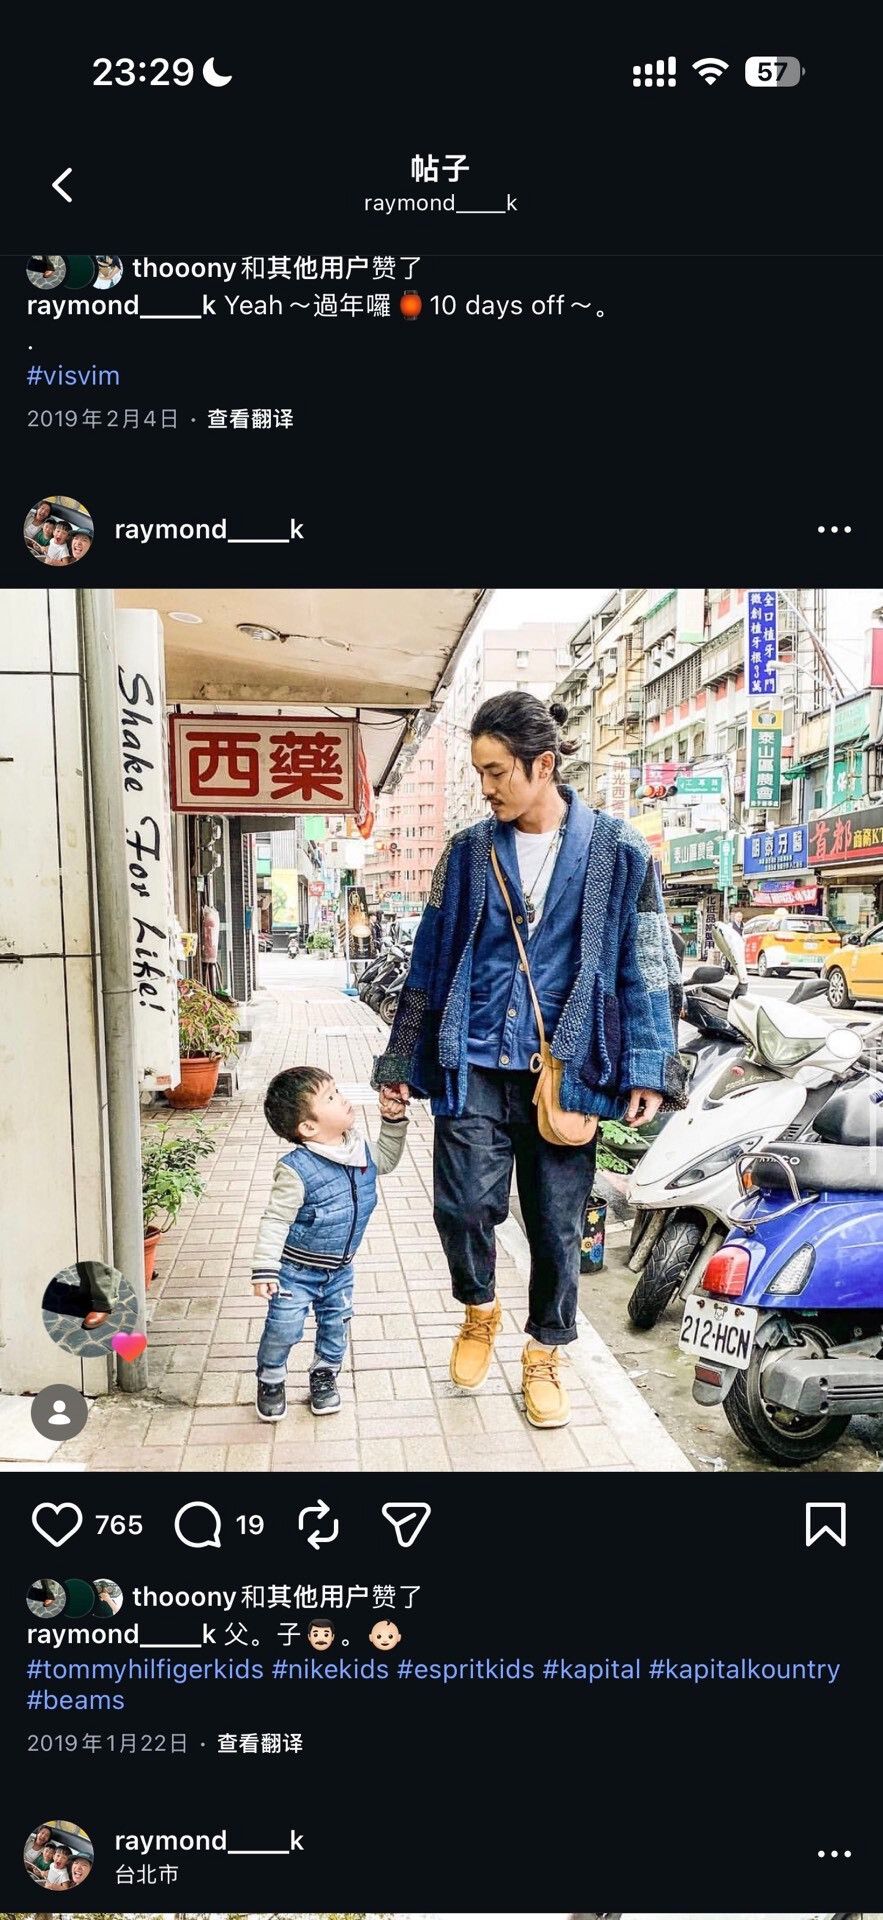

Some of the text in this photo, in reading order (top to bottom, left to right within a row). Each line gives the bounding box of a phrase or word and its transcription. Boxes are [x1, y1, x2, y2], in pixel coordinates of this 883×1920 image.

[93, 58, 788, 87] 23:29 57
[411, 154, 470, 183] 帖子
[430, 295, 457, 316] 10
[466, 294, 523, 320] days
[27, 365, 120, 386] #visvim
[208, 408, 294, 429] 查看翻译
[118, 664, 155, 792] Shake
[185, 730, 344, 801] 西藥
[809, 817, 852, 861] 首都
[126, 816, 161, 898] For
[96, 1515, 265, 1536] 765 19
[27, 1658, 841, 1685] #tommyhilfigerkids #nikekids #espritkids #kapital #kapitalkountry
[27, 1689, 125, 1711] #beams
[217, 1733, 304, 1754] 查看翻译
[115, 1864, 179, 1885] 台北市
